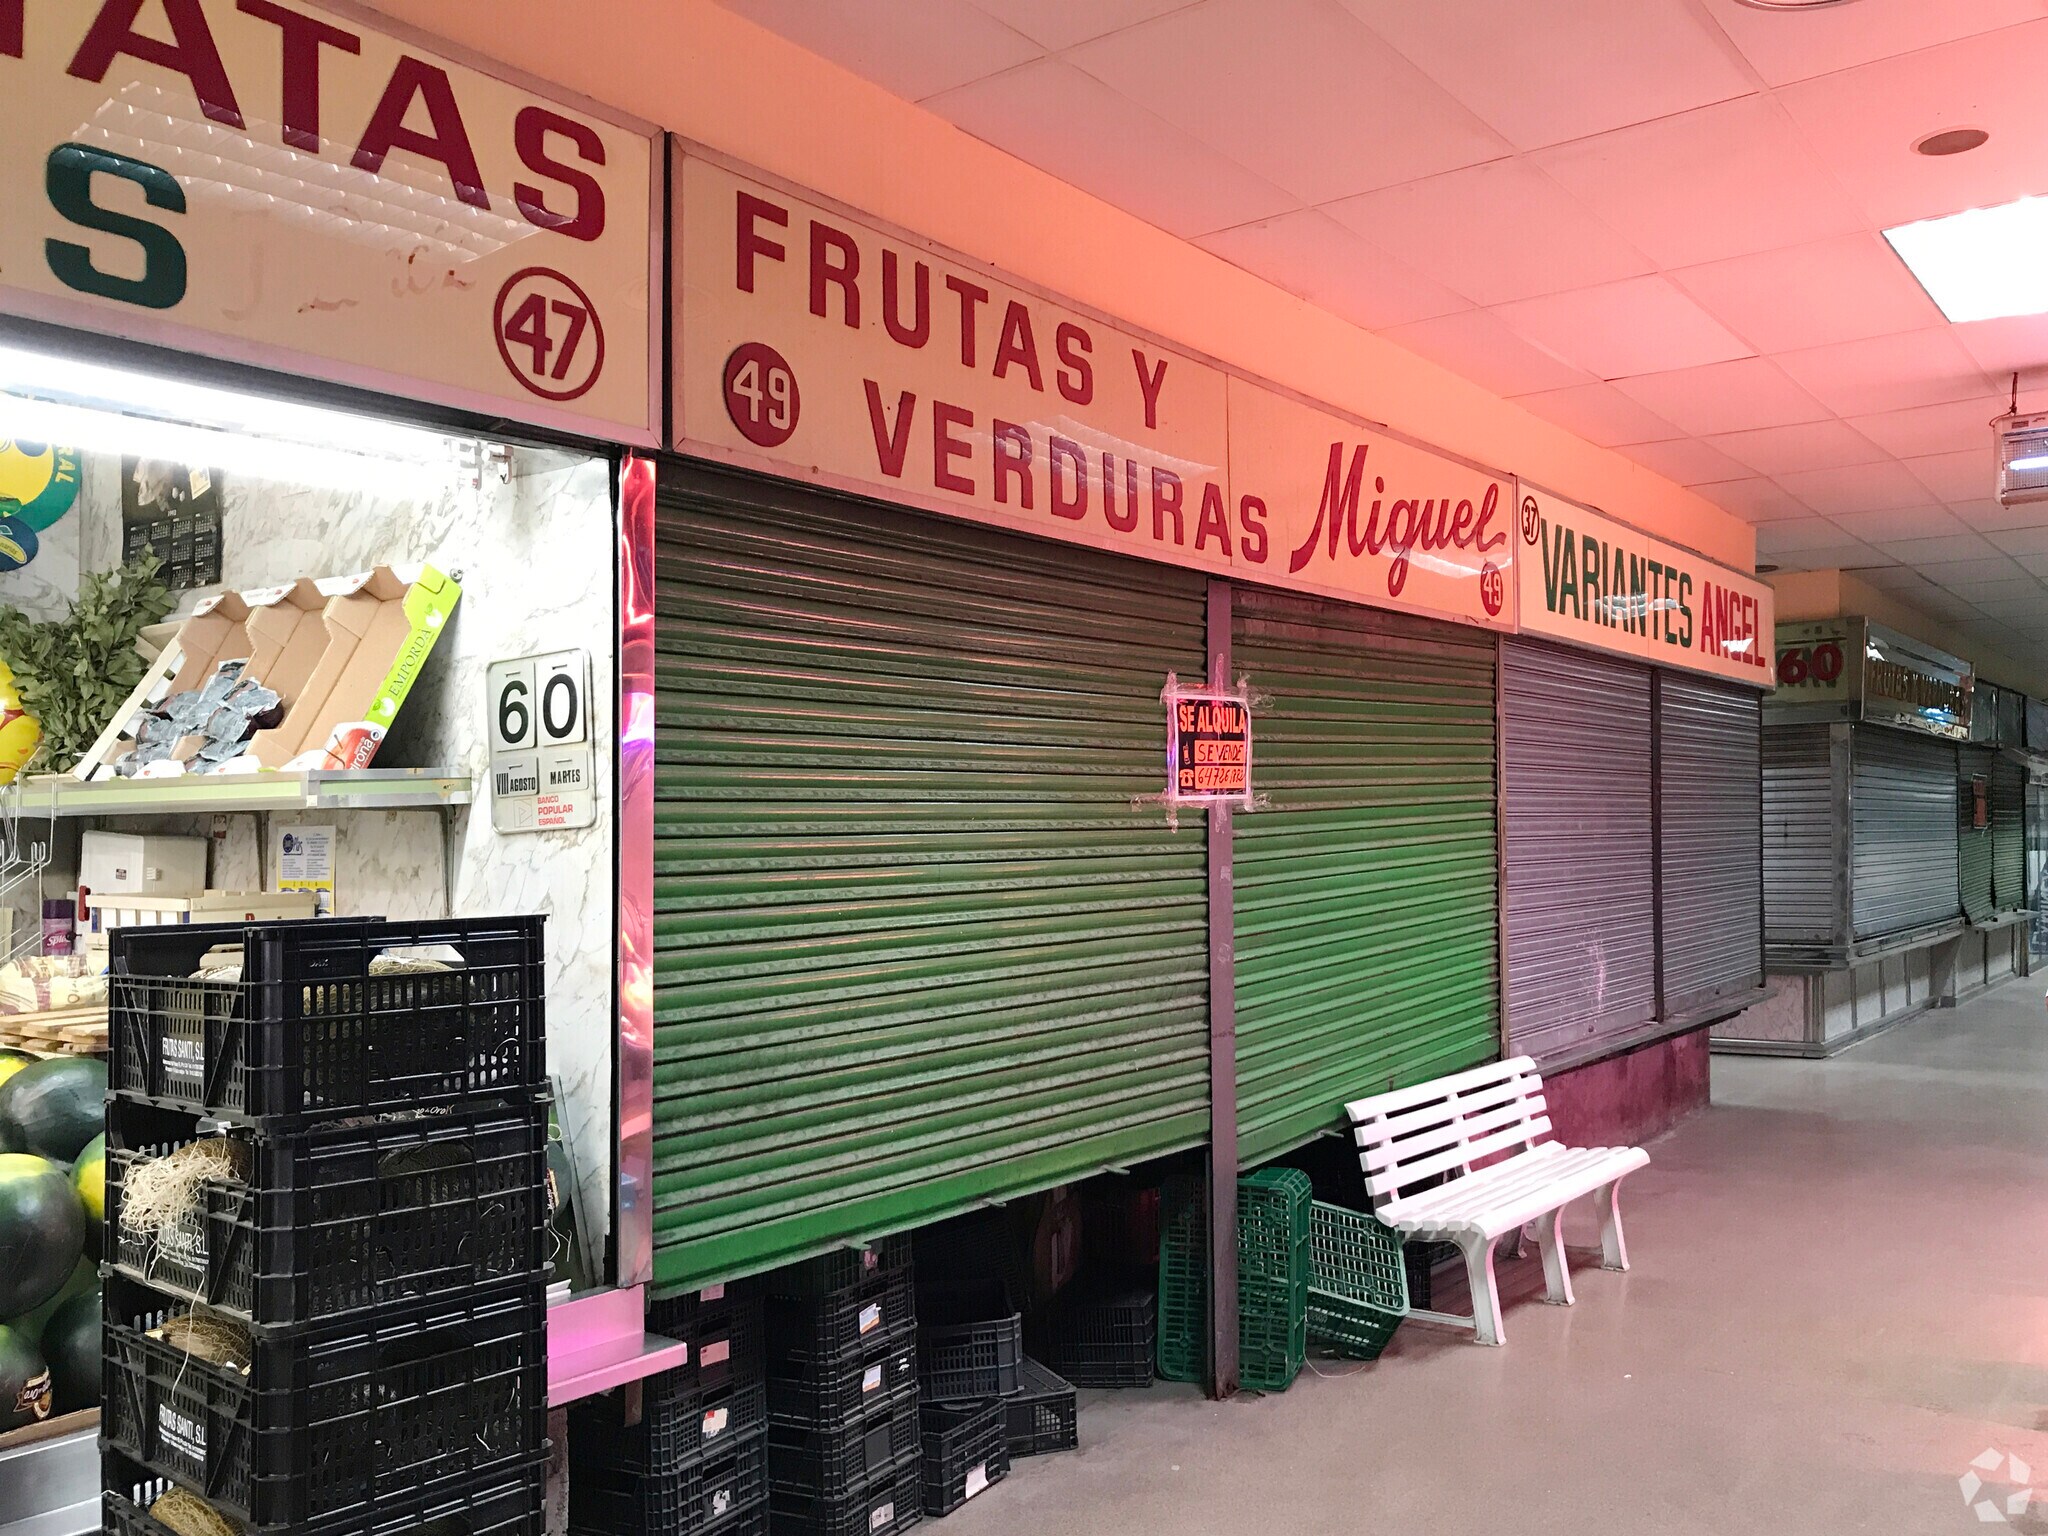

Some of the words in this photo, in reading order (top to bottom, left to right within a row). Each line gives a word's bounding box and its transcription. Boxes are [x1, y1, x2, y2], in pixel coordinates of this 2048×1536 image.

[46, 143, 186, 308] S
[736, 191, 1094, 406] FRUTAS
[1132, 349, 1168, 430] Y
[503, 292, 588, 380] 47
[732, 359, 793, 431] 49
[863, 378, 1268, 564] VERDURAS
[1290, 441, 1506, 597] Miguel
[1524, 504, 1538, 538] 37
[1483, 570, 1501, 607] 49
[1541, 517, 1693, 649] VARIANTES
[1700, 581, 1767, 669] ANGEL
[388, 628, 432, 697] EMPORDÀ
[1777, 643, 1844, 684] 60
[499, 674, 578, 744] 60
[1179, 705, 1194, 732] SE
[1197, 706, 1246, 734] ALQUILA
[1197, 744, 1213, 762] SE
[1215, 744, 1244, 761] VENDE
[496, 773, 509, 795] VIII
[510, 777, 536, 791] AGOSTO
[550, 769, 581, 785] MARTES
[537, 795, 559, 805] BANCO
[538, 804, 573, 816] POPULAR
[538, 816, 566, 826] ESPAÑOL
[162, 1037, 178, 1057] FRUTAS
[159, 1403, 177, 1432] FRUTAS
